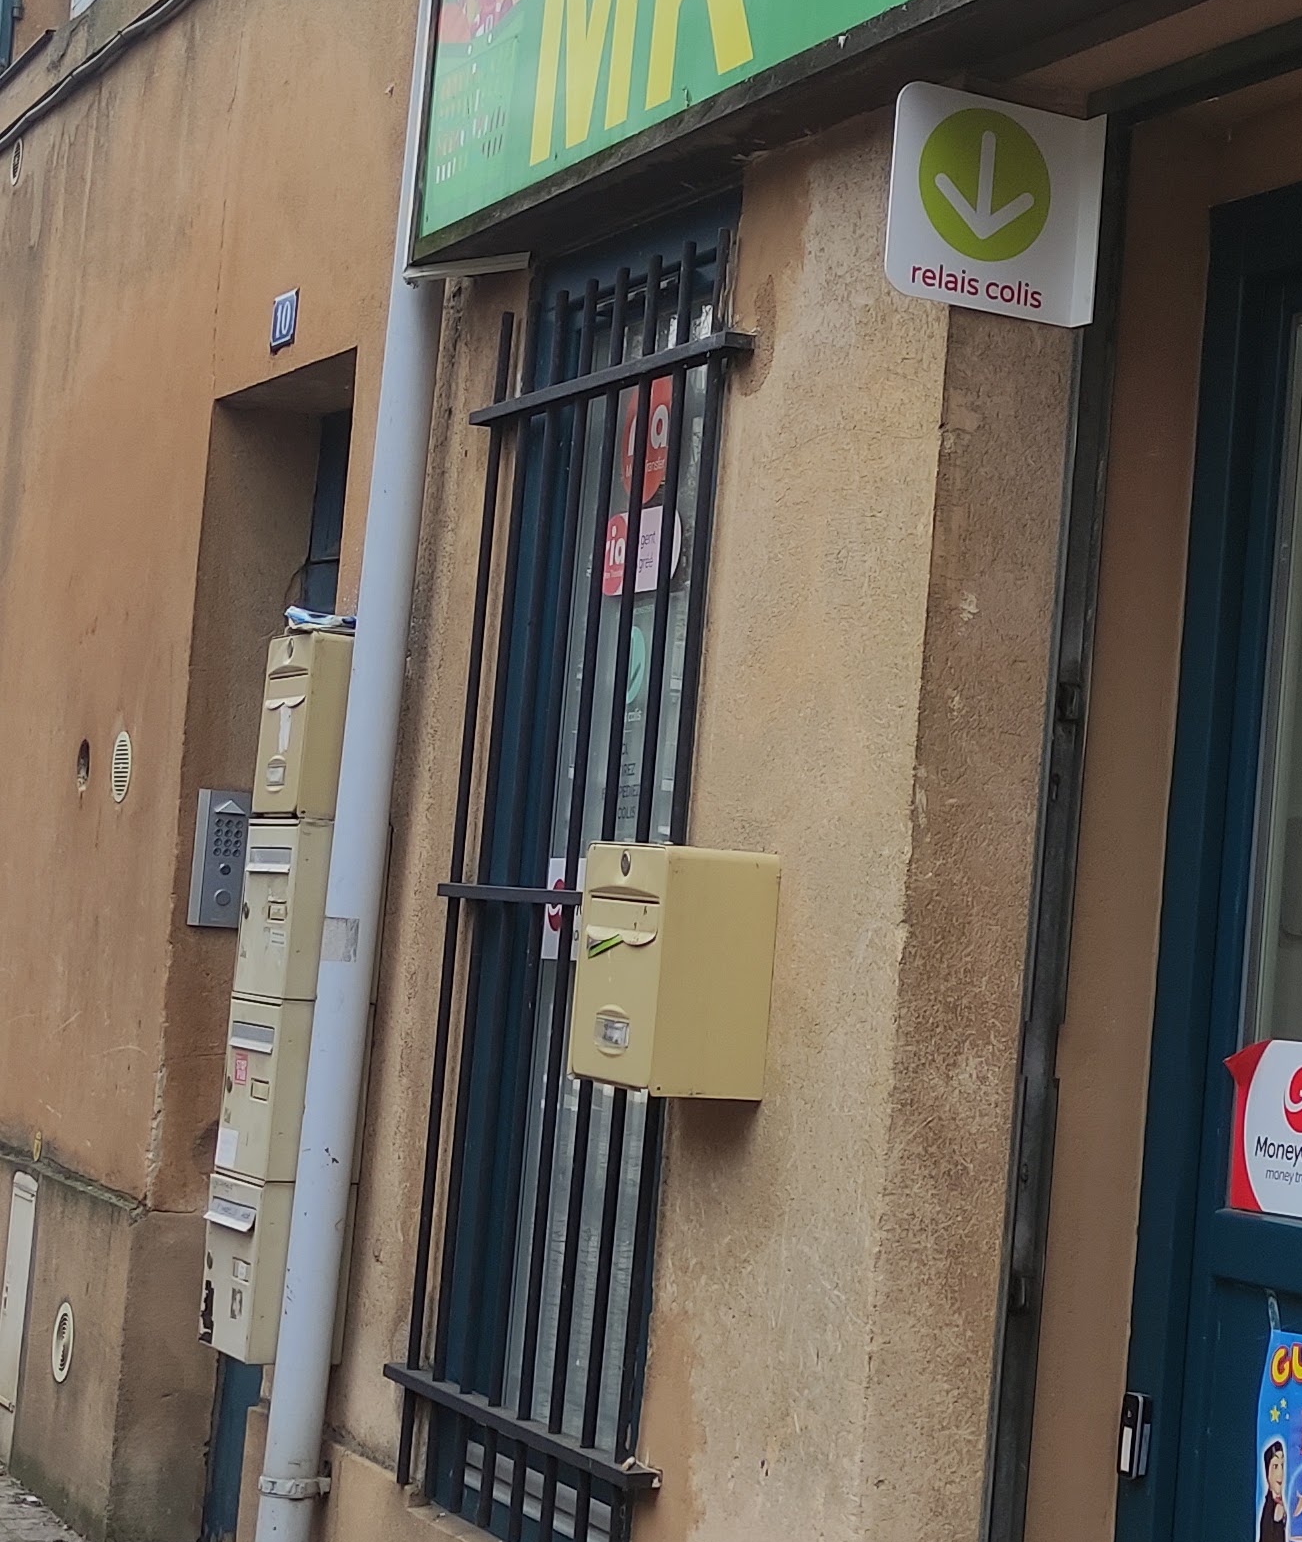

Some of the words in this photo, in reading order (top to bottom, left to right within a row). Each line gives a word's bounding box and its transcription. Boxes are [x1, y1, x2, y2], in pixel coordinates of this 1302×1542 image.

[911, 263, 980, 296] relais
[985, 280, 1042, 309] colis
[275, 300, 291, 339] 10
[1265, 1168, 1295, 1183] money
